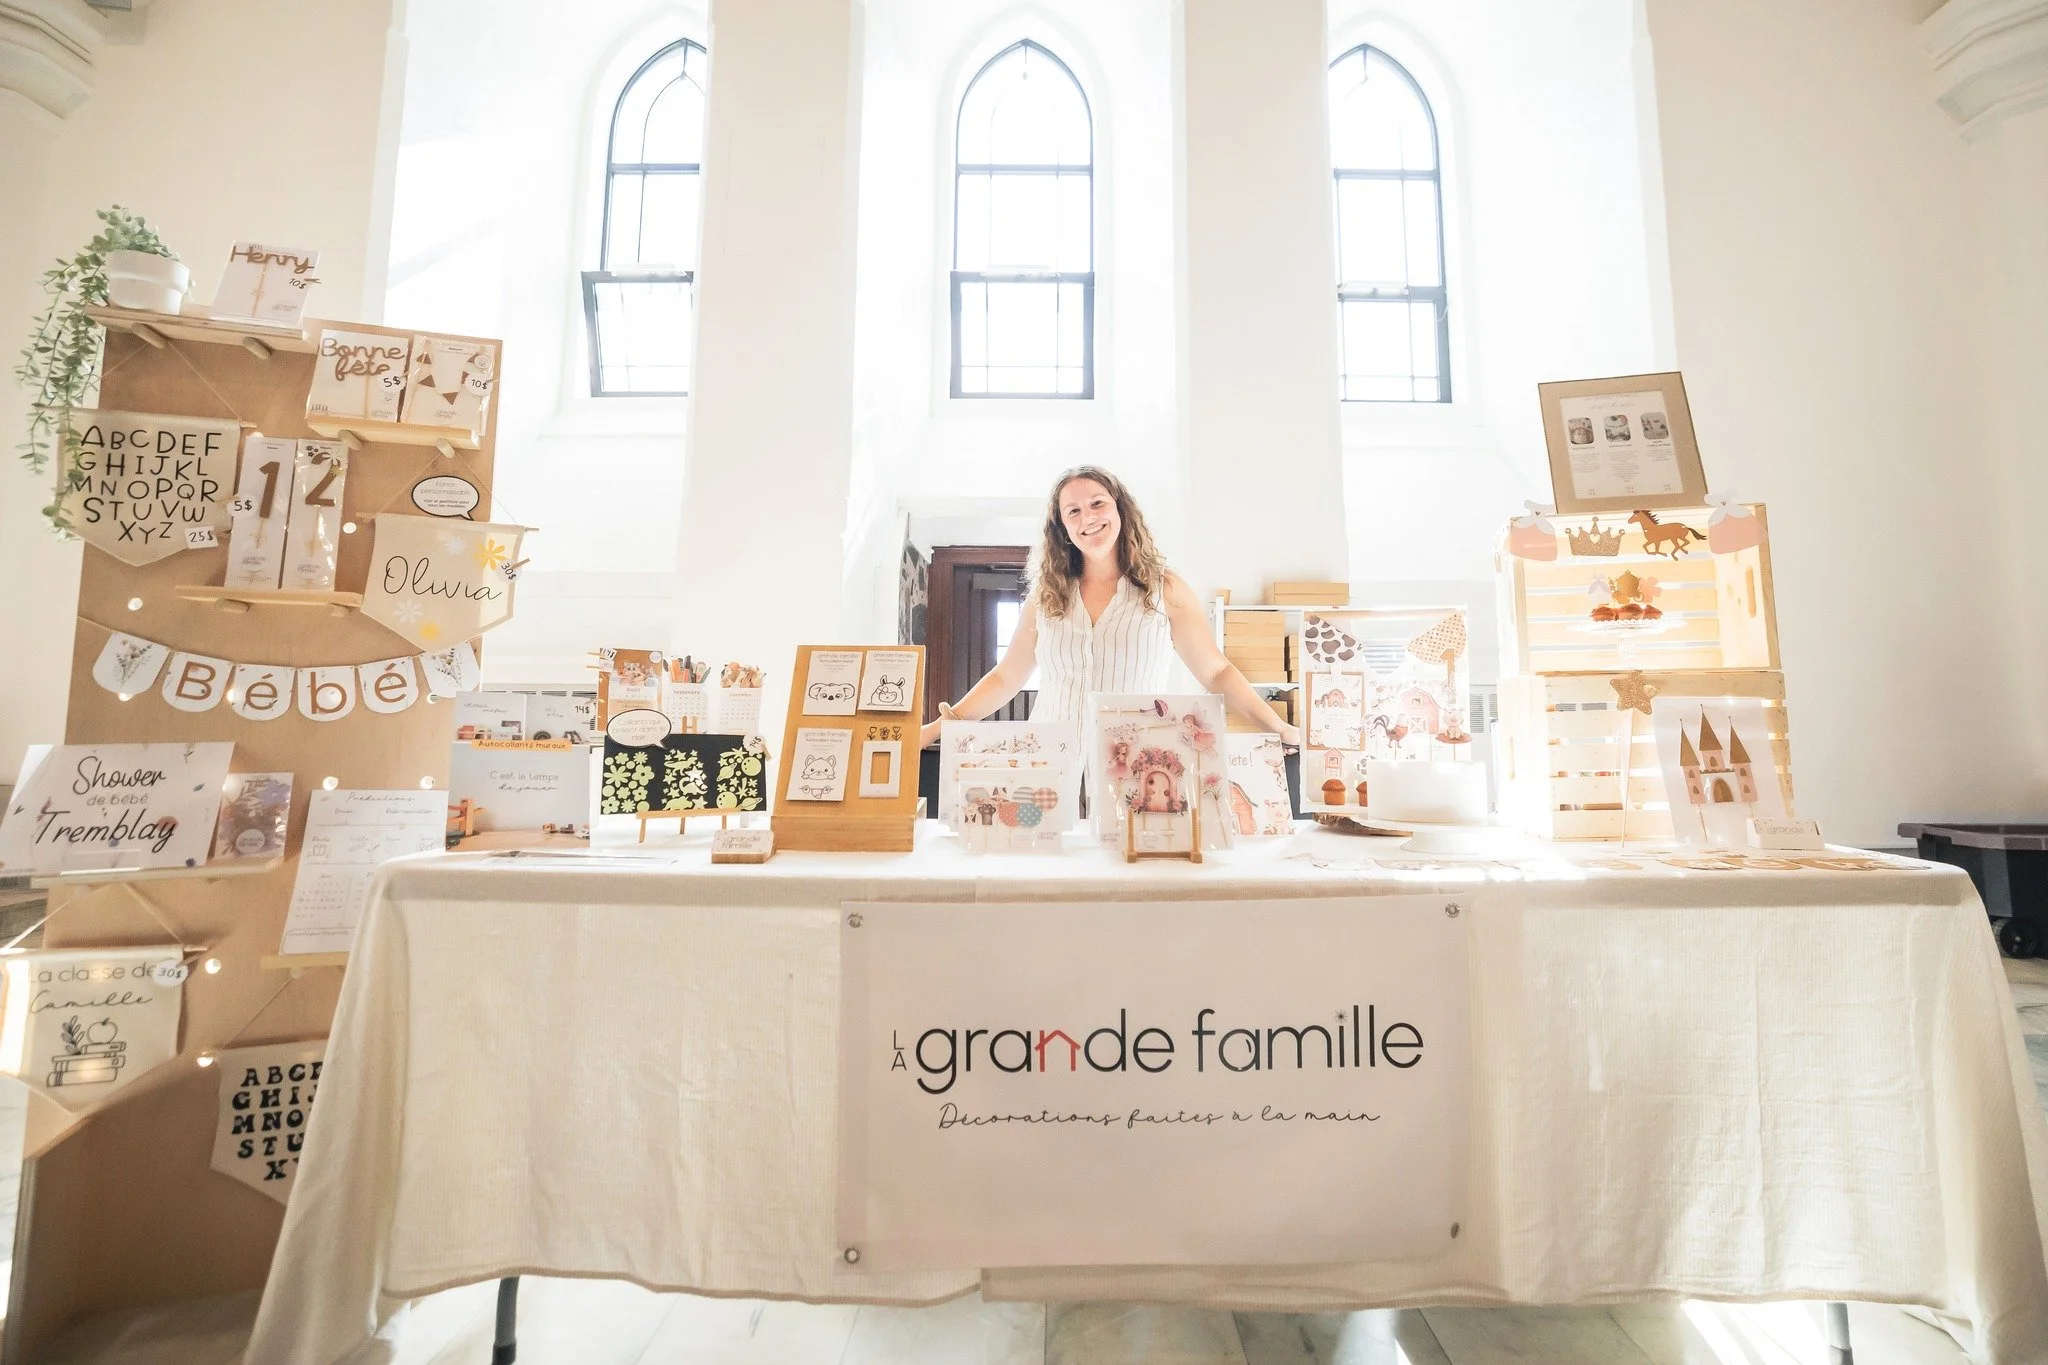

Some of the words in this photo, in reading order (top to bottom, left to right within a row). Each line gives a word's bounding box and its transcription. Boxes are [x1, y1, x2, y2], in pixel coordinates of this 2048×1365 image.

[230, 245, 315, 275] Henry
[288, 278, 307, 290] 10$
[320, 337, 406, 359] Bonne
[382, 375, 401, 388] 5$
[470, 379, 488, 391] 10$
[80, 425, 222, 457] ABCDEF
[76, 451, 208, 482] GHIJKL
[304, 451, 341, 507] 2
[258, 461, 281, 519] 1
[83, 497, 206, 524] STUVW
[233, 499, 253, 512] 5$
[117, 520, 174, 545] XYZ
[188, 531, 214, 544] 25$
[383, 555, 503, 601] Olivia
[500, 562, 518, 581] 30$
[174, 660, 409, 716] Bébé
[574, 705, 591, 715] 14$
[477, 739, 534, 749] Autocollants
[72, 755, 168, 795] Shower
[518, 771, 526, 780] le
[528, 770, 559, 782] temps
[86, 795, 107, 807] de
[109, 794, 149, 806] bébé
[35, 808, 180, 854] Tremblay
[58, 965, 126, 983] classe
[30, 989, 154, 1014] Camille
[915, 1007, 1176, 1095] grande
[1191, 1003, 1425, 1073] famille
[937, 1102, 1122, 1130] Décorations
[1126, 1107, 1224, 1130] faites
[1231, 1111, 1253, 1122] à
[1260, 1104, 1297, 1123] la
[1303, 1110, 1382, 1122] main
